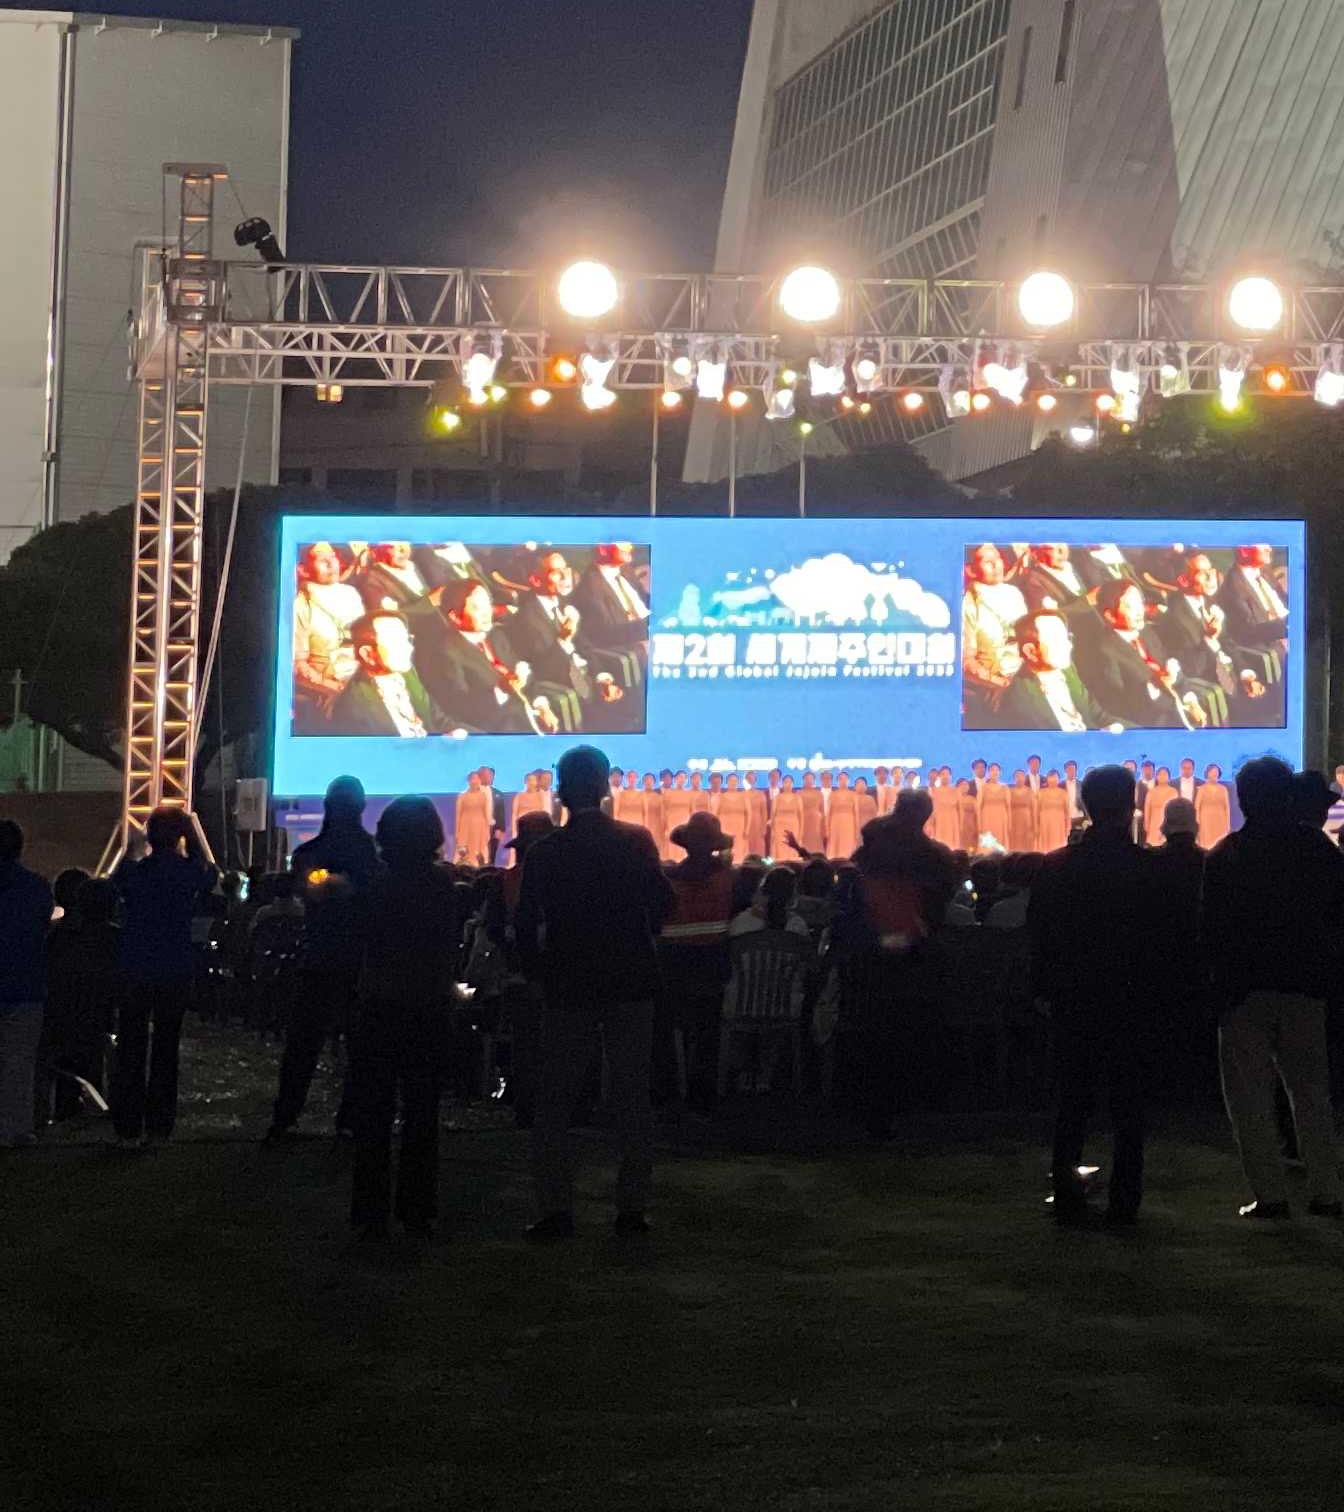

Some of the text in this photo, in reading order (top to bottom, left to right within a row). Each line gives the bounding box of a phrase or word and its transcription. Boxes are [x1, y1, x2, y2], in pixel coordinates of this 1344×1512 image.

[652, 632, 737, 665] 제2회
[652, 665, 682, 679] The
[725, 665, 780, 679] Global
[843, 665, 911, 679] Festival
